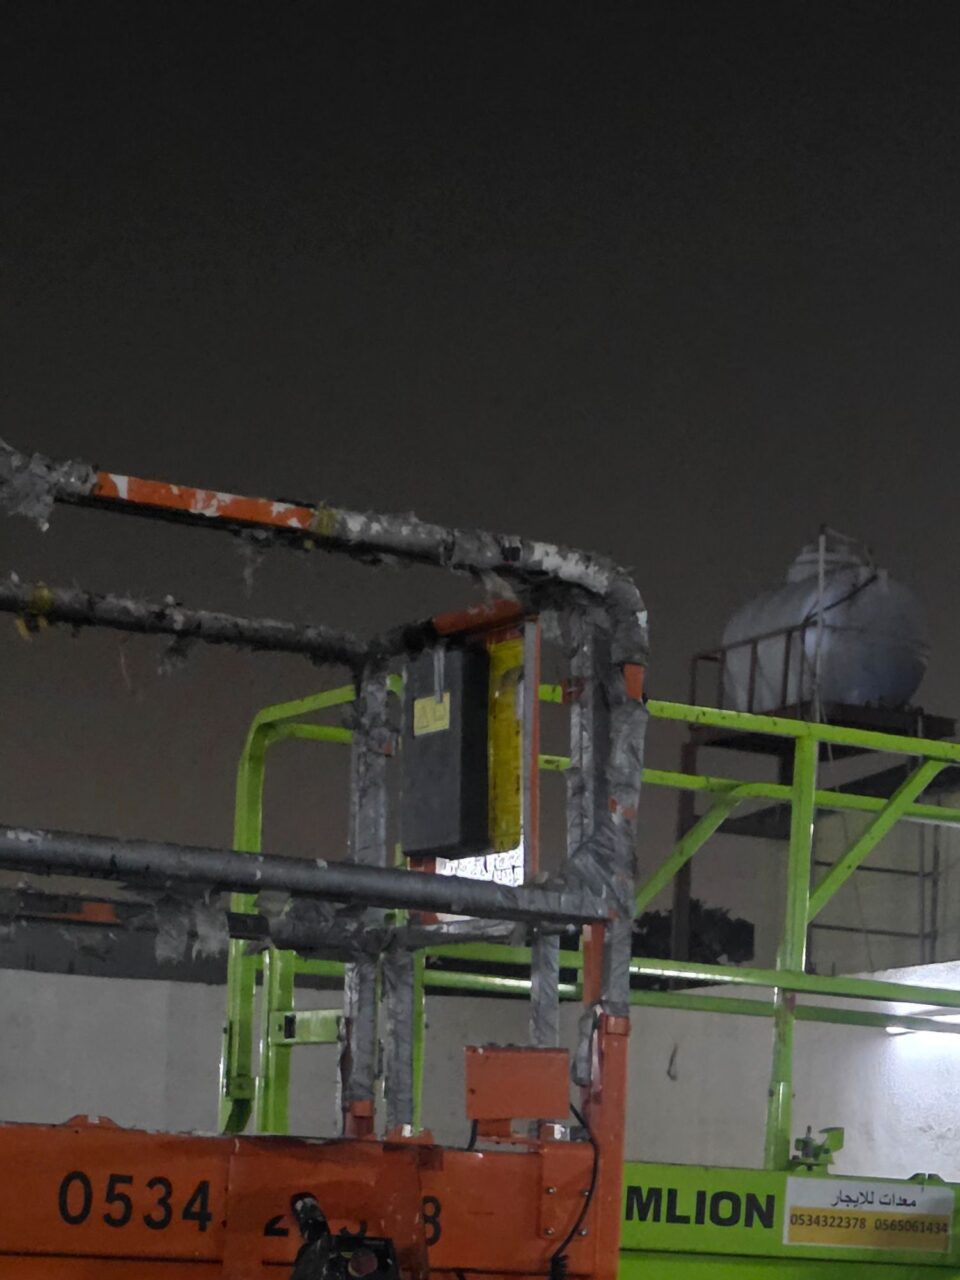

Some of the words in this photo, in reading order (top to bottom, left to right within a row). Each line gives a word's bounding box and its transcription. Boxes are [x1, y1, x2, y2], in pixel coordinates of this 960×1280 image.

[625, 1185, 775, 1229] MLION
[879, 1192, 917, 1208] معدات
[790, 1213, 866, 1230] 0534322378
